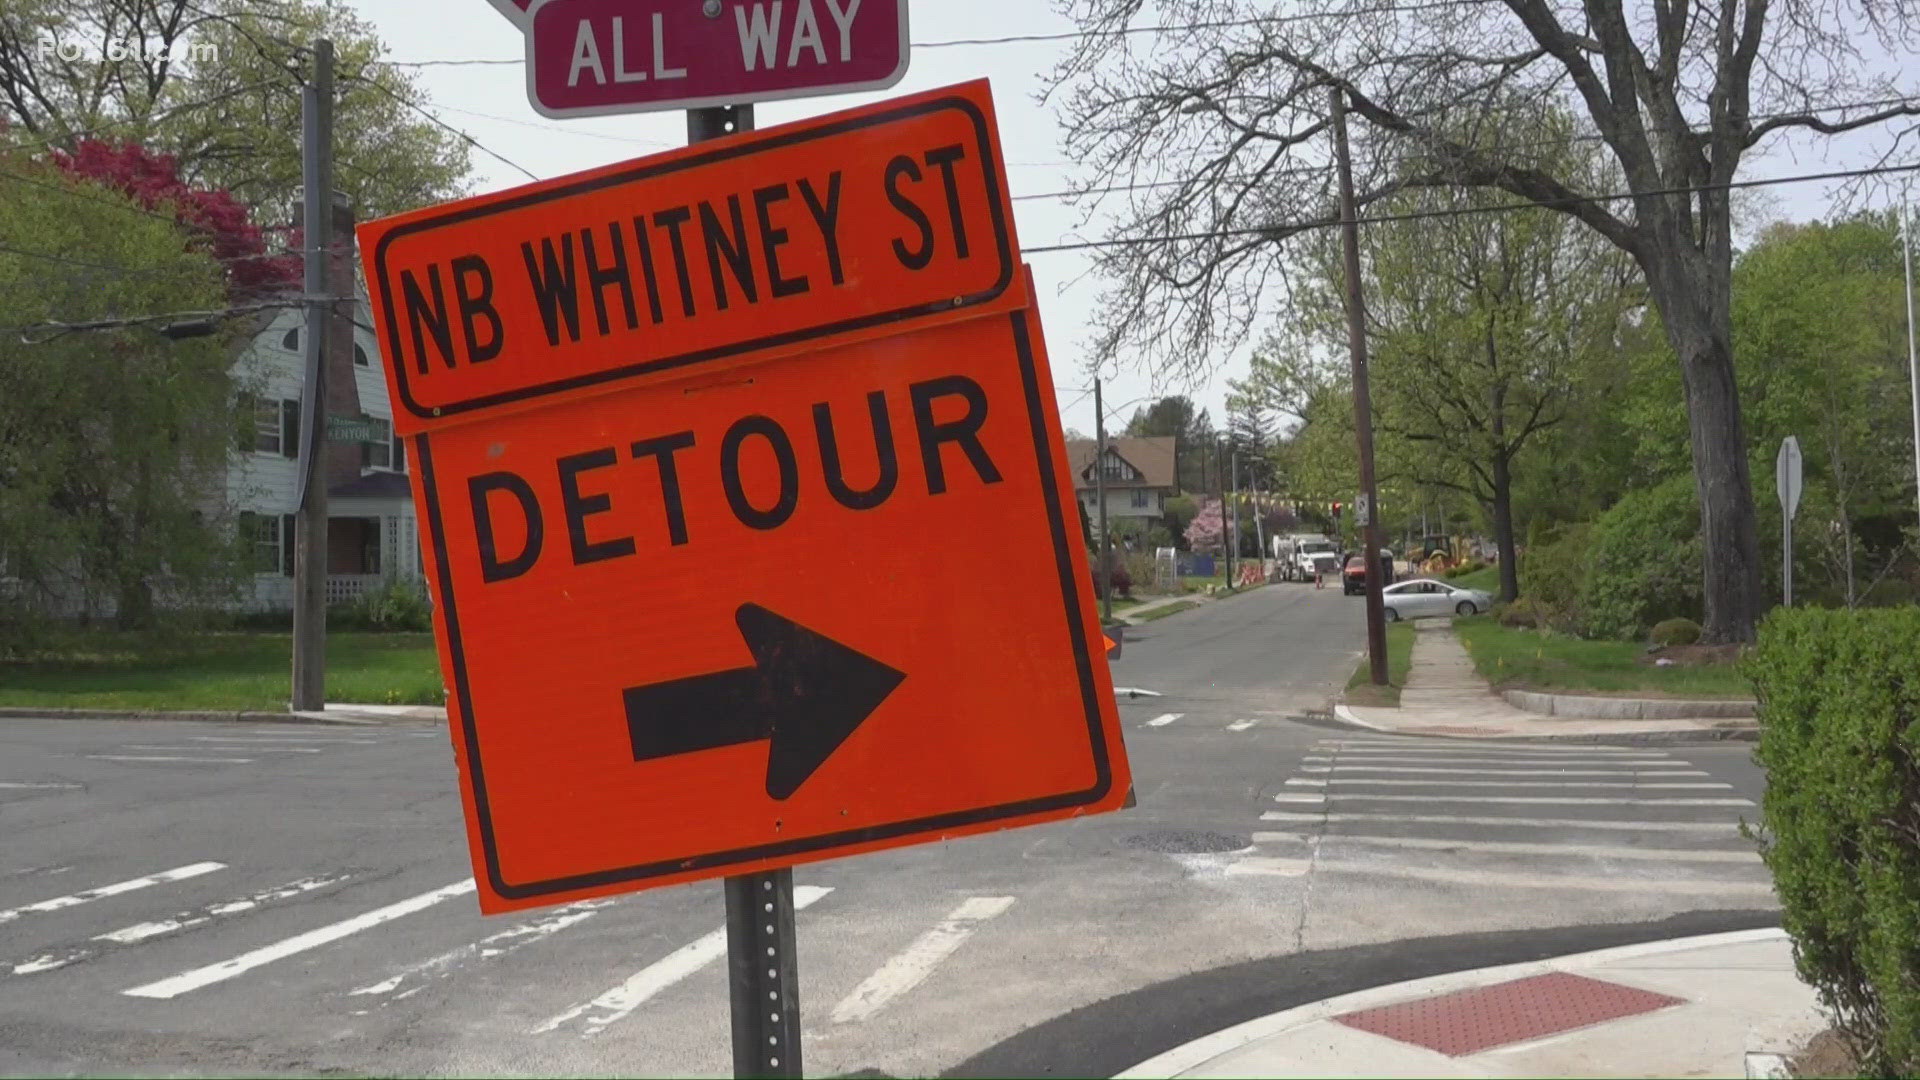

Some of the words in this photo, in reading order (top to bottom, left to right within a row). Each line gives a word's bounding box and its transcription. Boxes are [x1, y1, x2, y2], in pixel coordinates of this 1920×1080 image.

[568, 13, 687, 86] ALL
[734, 0, 861, 71] WAY
[400, 255, 504, 375] NB
[521, 171, 844, 346] WHITNEY
[884, 144, 969, 271] ST
[328, 427, 369, 440] KENYON
[468, 375, 1003, 583] DETOUR
